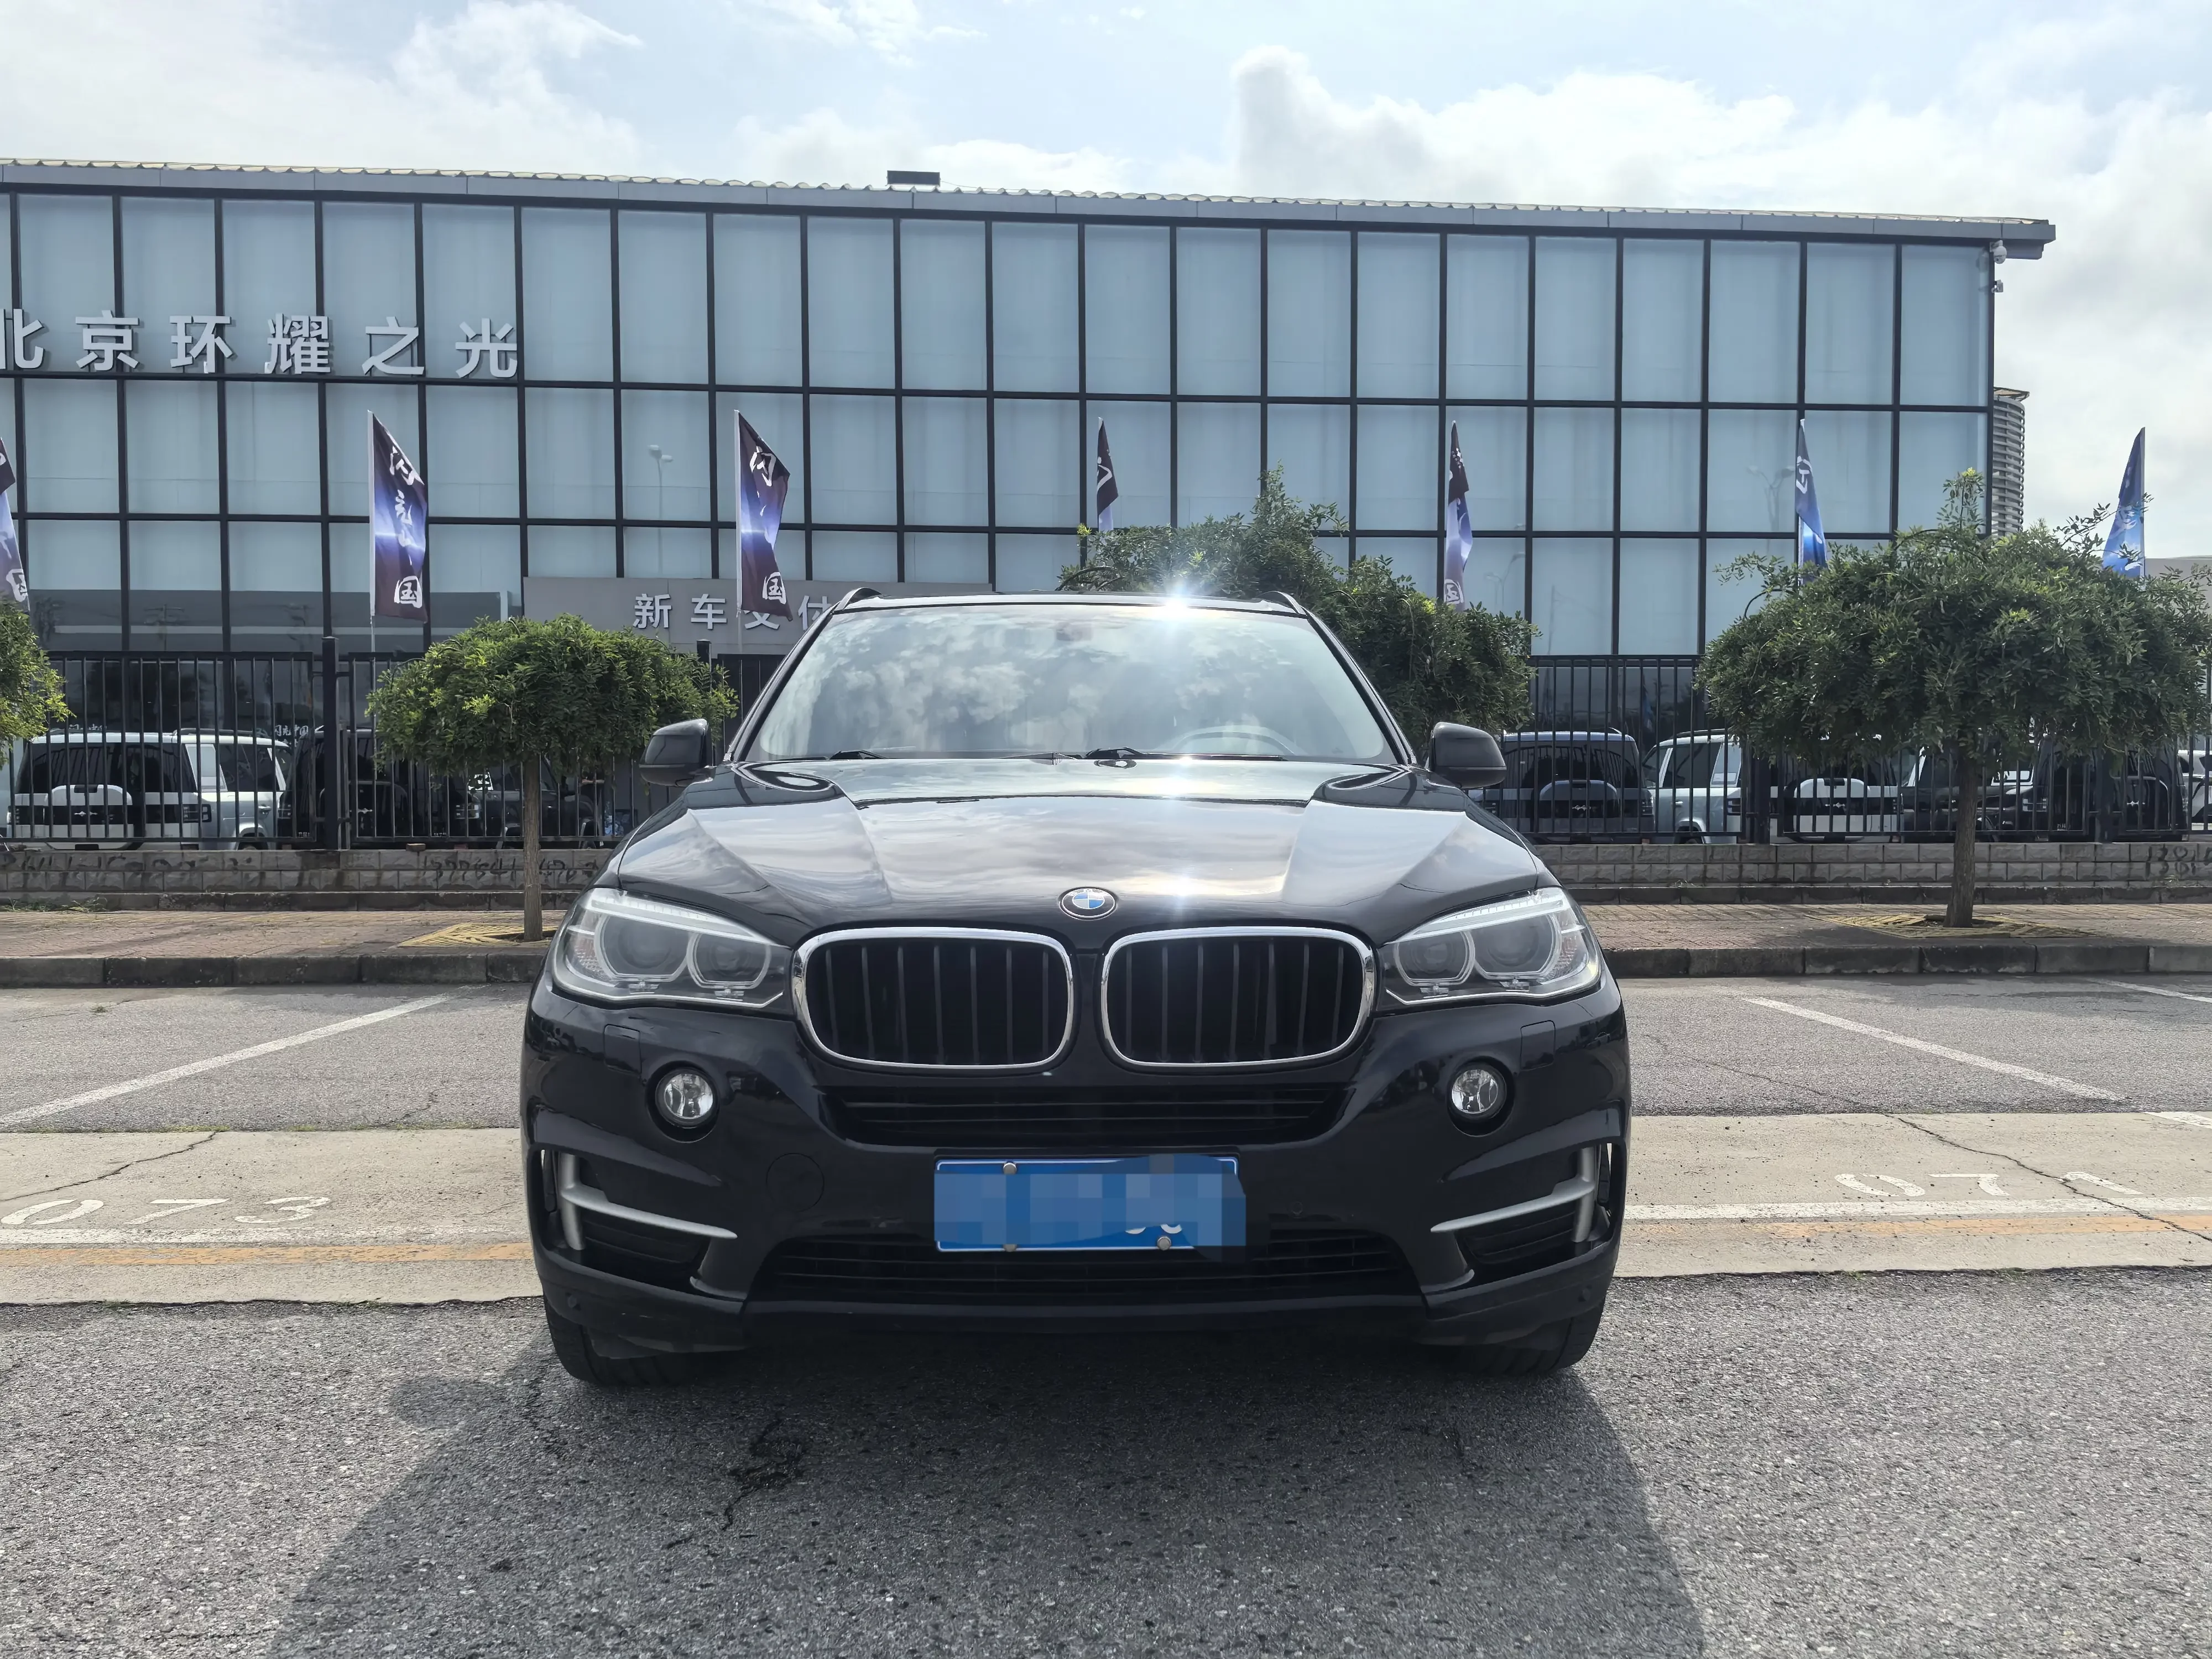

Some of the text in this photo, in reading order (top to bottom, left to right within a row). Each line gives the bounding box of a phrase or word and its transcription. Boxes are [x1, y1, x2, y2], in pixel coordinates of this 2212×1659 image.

[0, 308, 518, 378] 北京环耀之光
[1834, 1171, 2144, 1197] 071
[1, 1196, 330, 1225] 073
